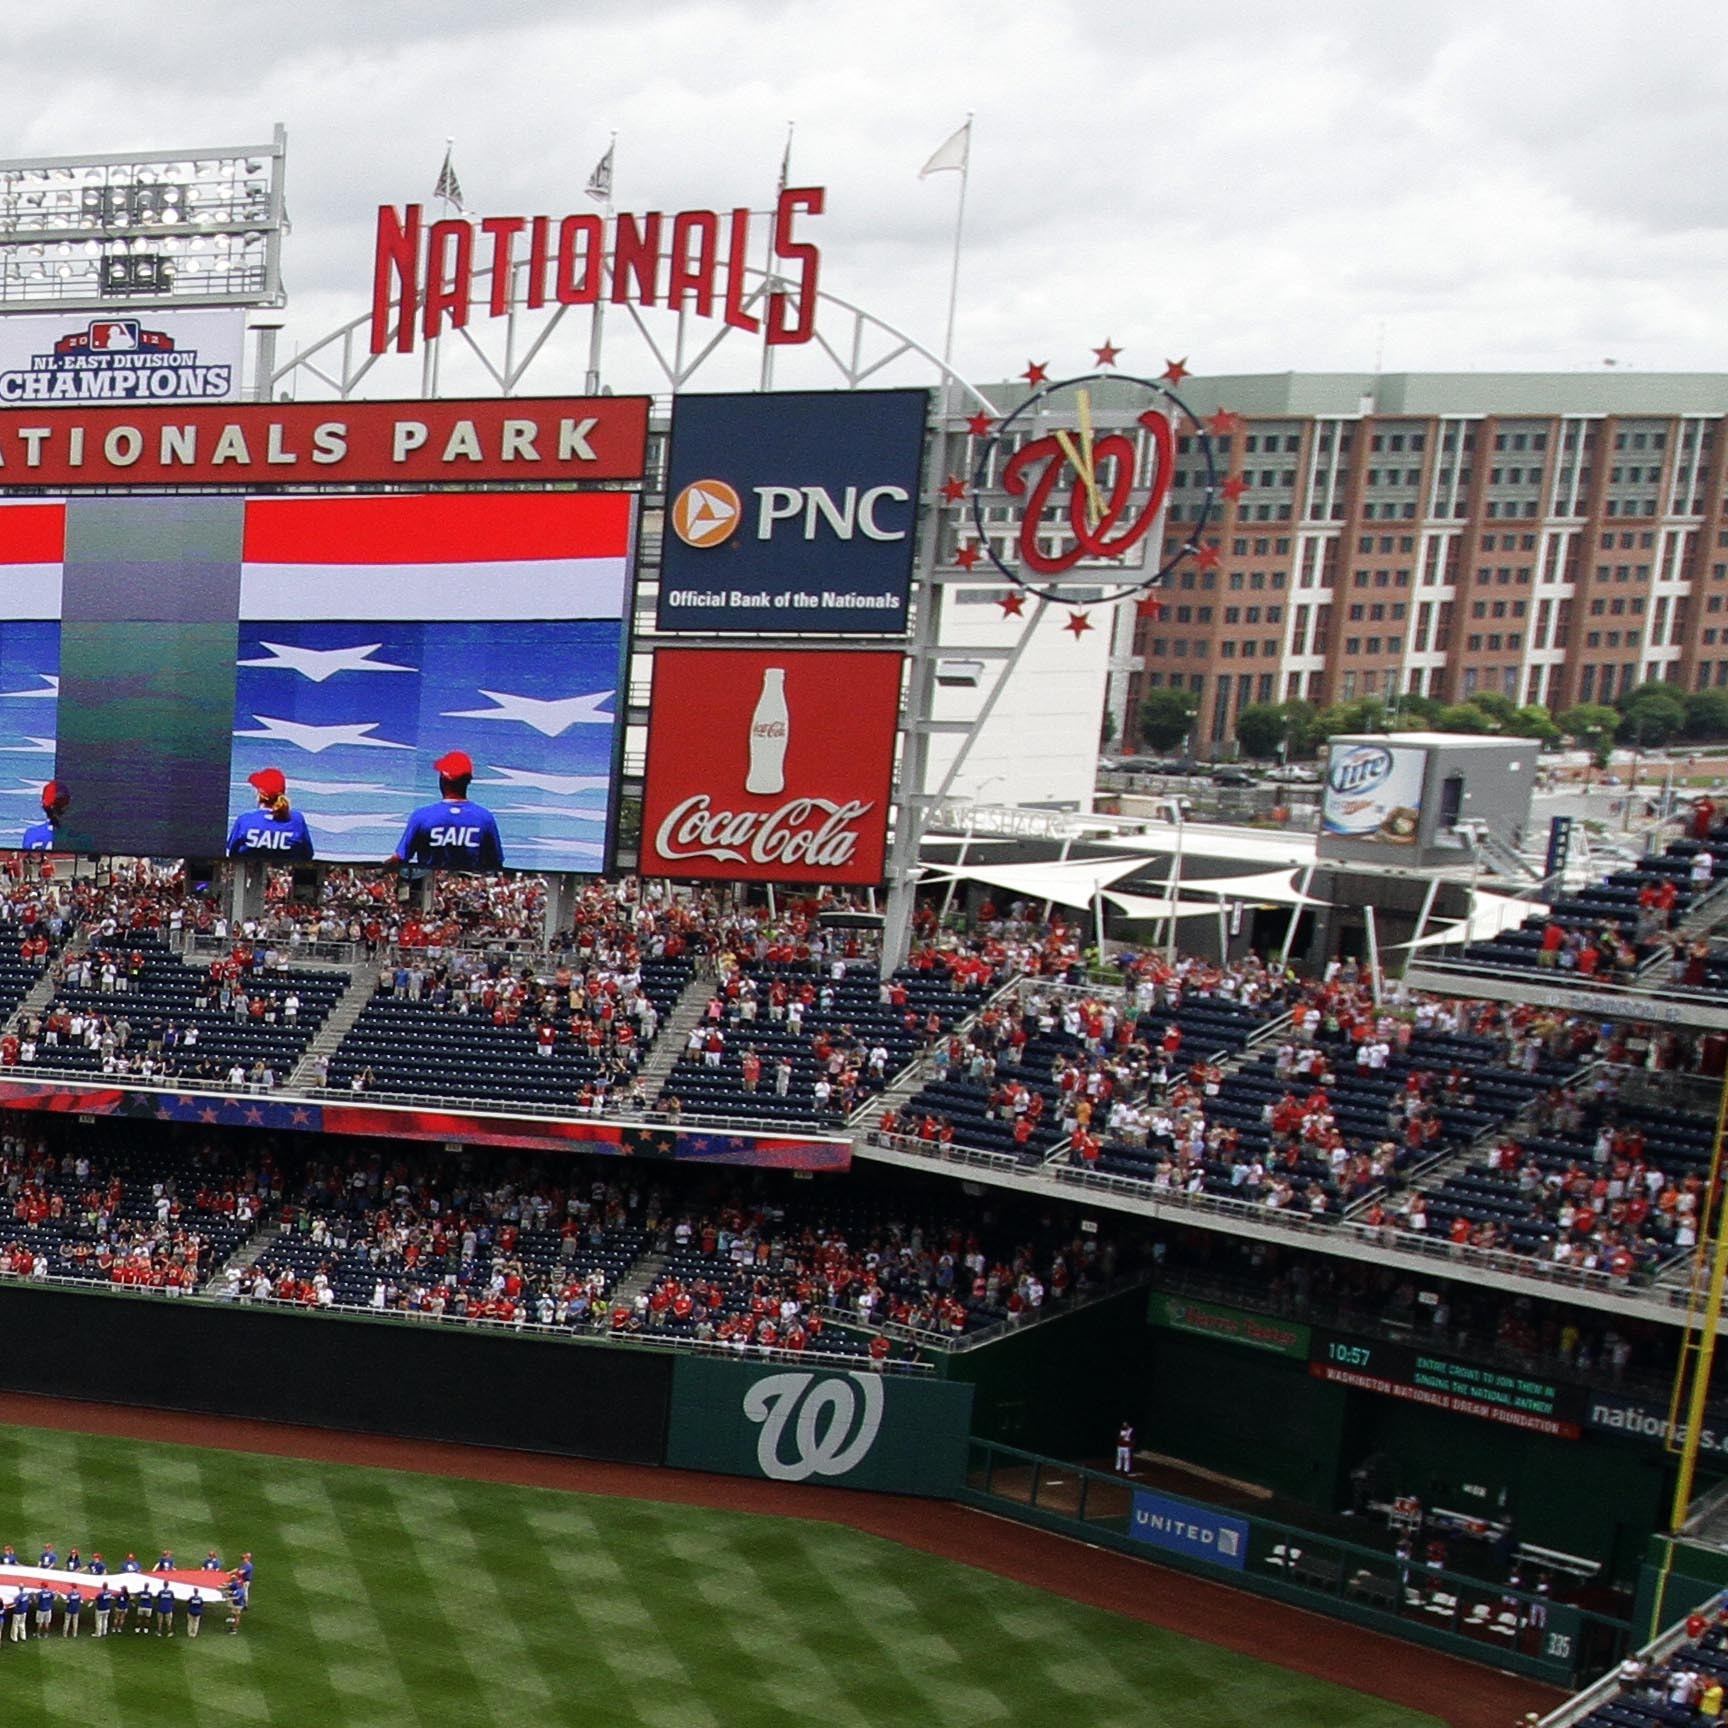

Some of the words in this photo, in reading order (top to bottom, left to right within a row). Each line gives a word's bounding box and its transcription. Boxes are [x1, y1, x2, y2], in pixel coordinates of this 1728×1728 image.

[371, 186, 826, 354] NATIONALS
[113, 353, 195, 368] DIVISION
[0, 367, 229, 400] CHAMPIONS
[392, 418, 599, 462] PARK
[753, 486, 908, 542] PNC
[669, 590, 726, 608] Official
[729, 590, 769, 608] Bank
[774, 591, 790, 607] of
[792, 591, 819, 608] the
[821, 592, 900, 610] Nationals
[244, 827, 295, 851] SAIC
[428, 825, 481, 849] SAIC
[656, 794, 874, 867] Coca-Cola
[1328, 1343, 1371, 1367] 10:57
[1136, 1510, 1214, 1544] UNITED
[1549, 1632, 1572, 1660] 335
